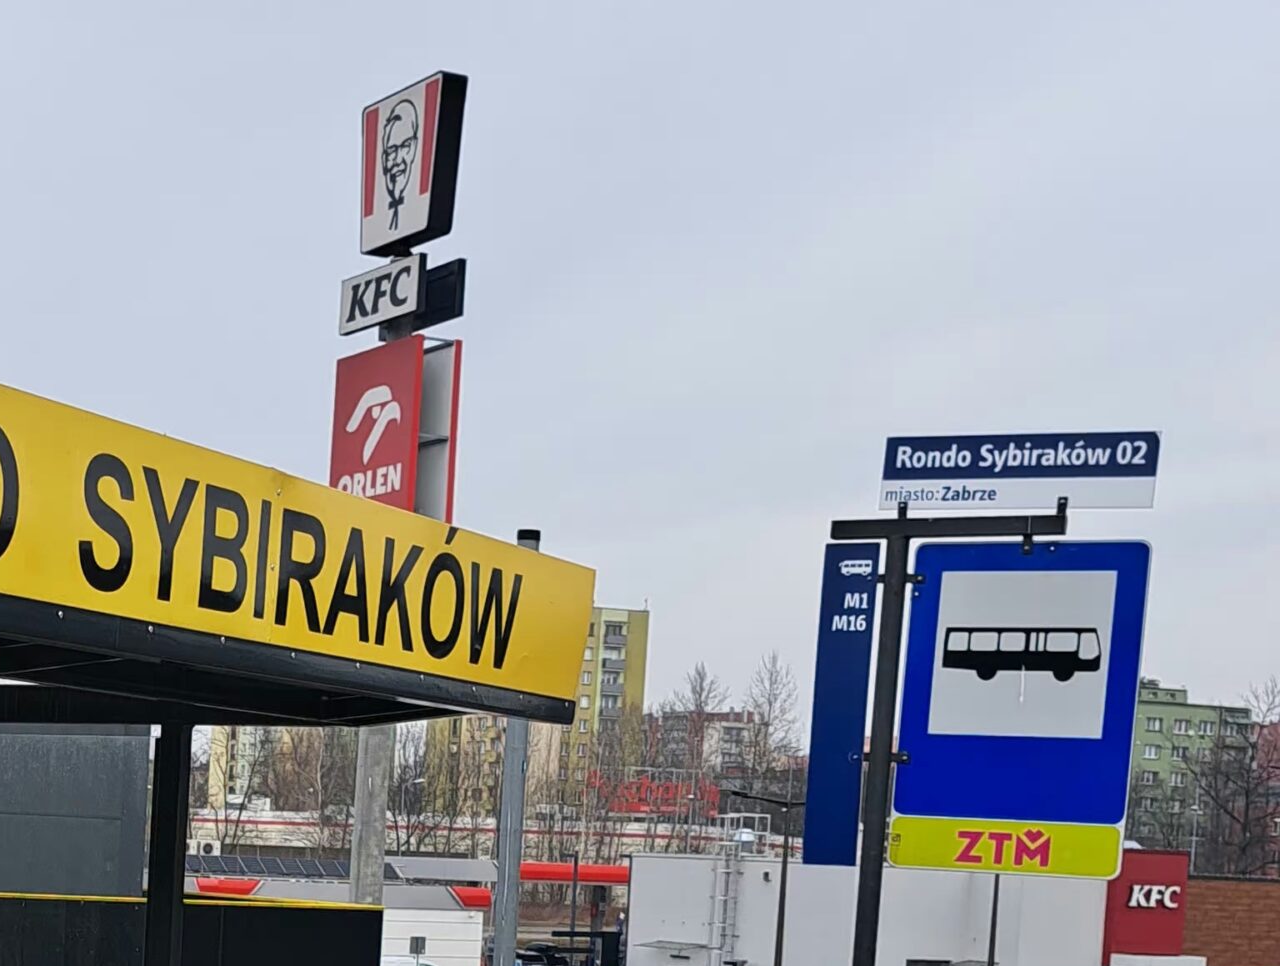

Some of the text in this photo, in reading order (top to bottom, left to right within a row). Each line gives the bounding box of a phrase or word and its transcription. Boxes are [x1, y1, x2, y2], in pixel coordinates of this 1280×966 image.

[345, 265, 412, 324] KFC
[895, 440, 1148, 473] Rondo Sybiraków 02
[78, 452, 524, 670] SYBIRAKÓW
[843, 592, 869, 609] M1
[831, 614, 867, 632] M16
[953, 828, 1052, 868] ZTM
[1127, 884, 1182, 908] KFC
